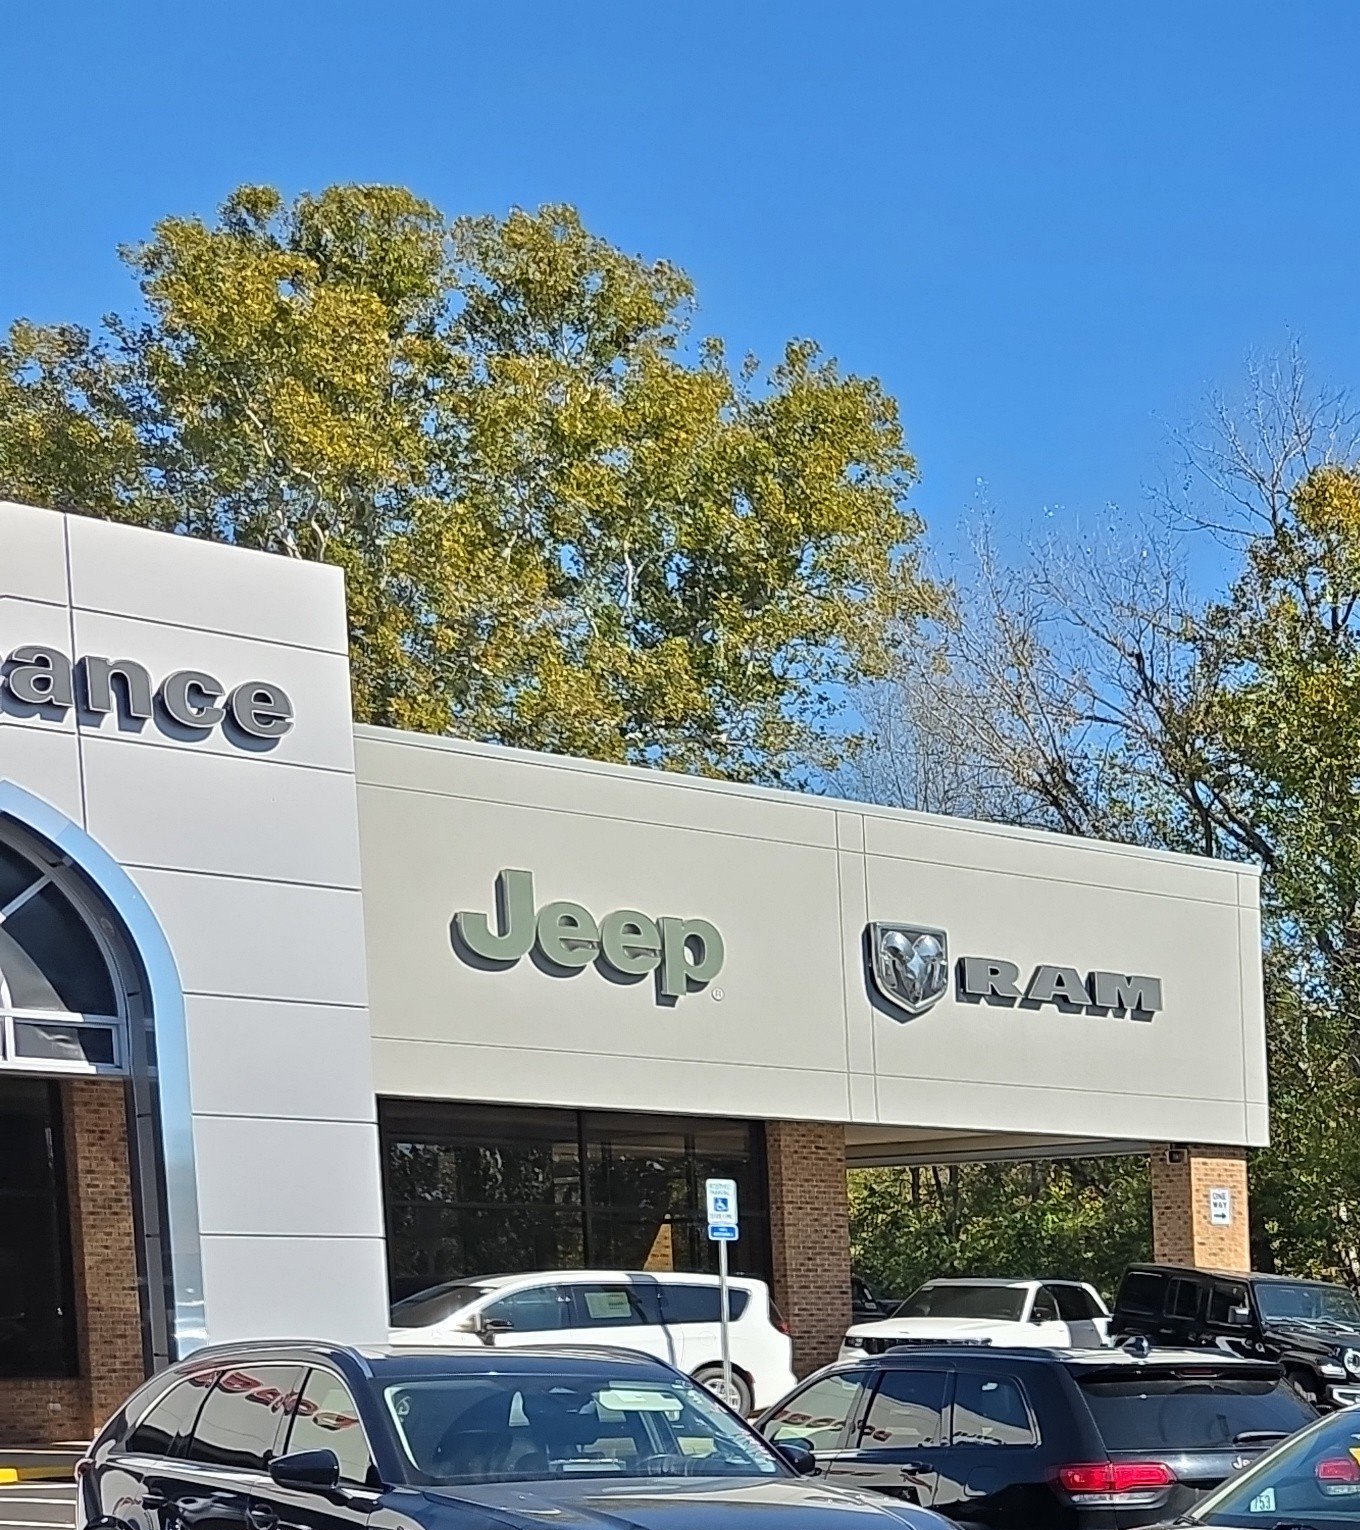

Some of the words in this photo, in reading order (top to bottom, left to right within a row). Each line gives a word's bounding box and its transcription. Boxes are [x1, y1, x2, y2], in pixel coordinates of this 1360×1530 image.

[452, 869, 724, 999] Jeep
[956, 957, 1163, 1017] RAM
[1212, 1192, 1227, 1201] ONE
[1212, 1201, 1227, 1209] WAY
[1231, 1456, 1251, 1470] Je
